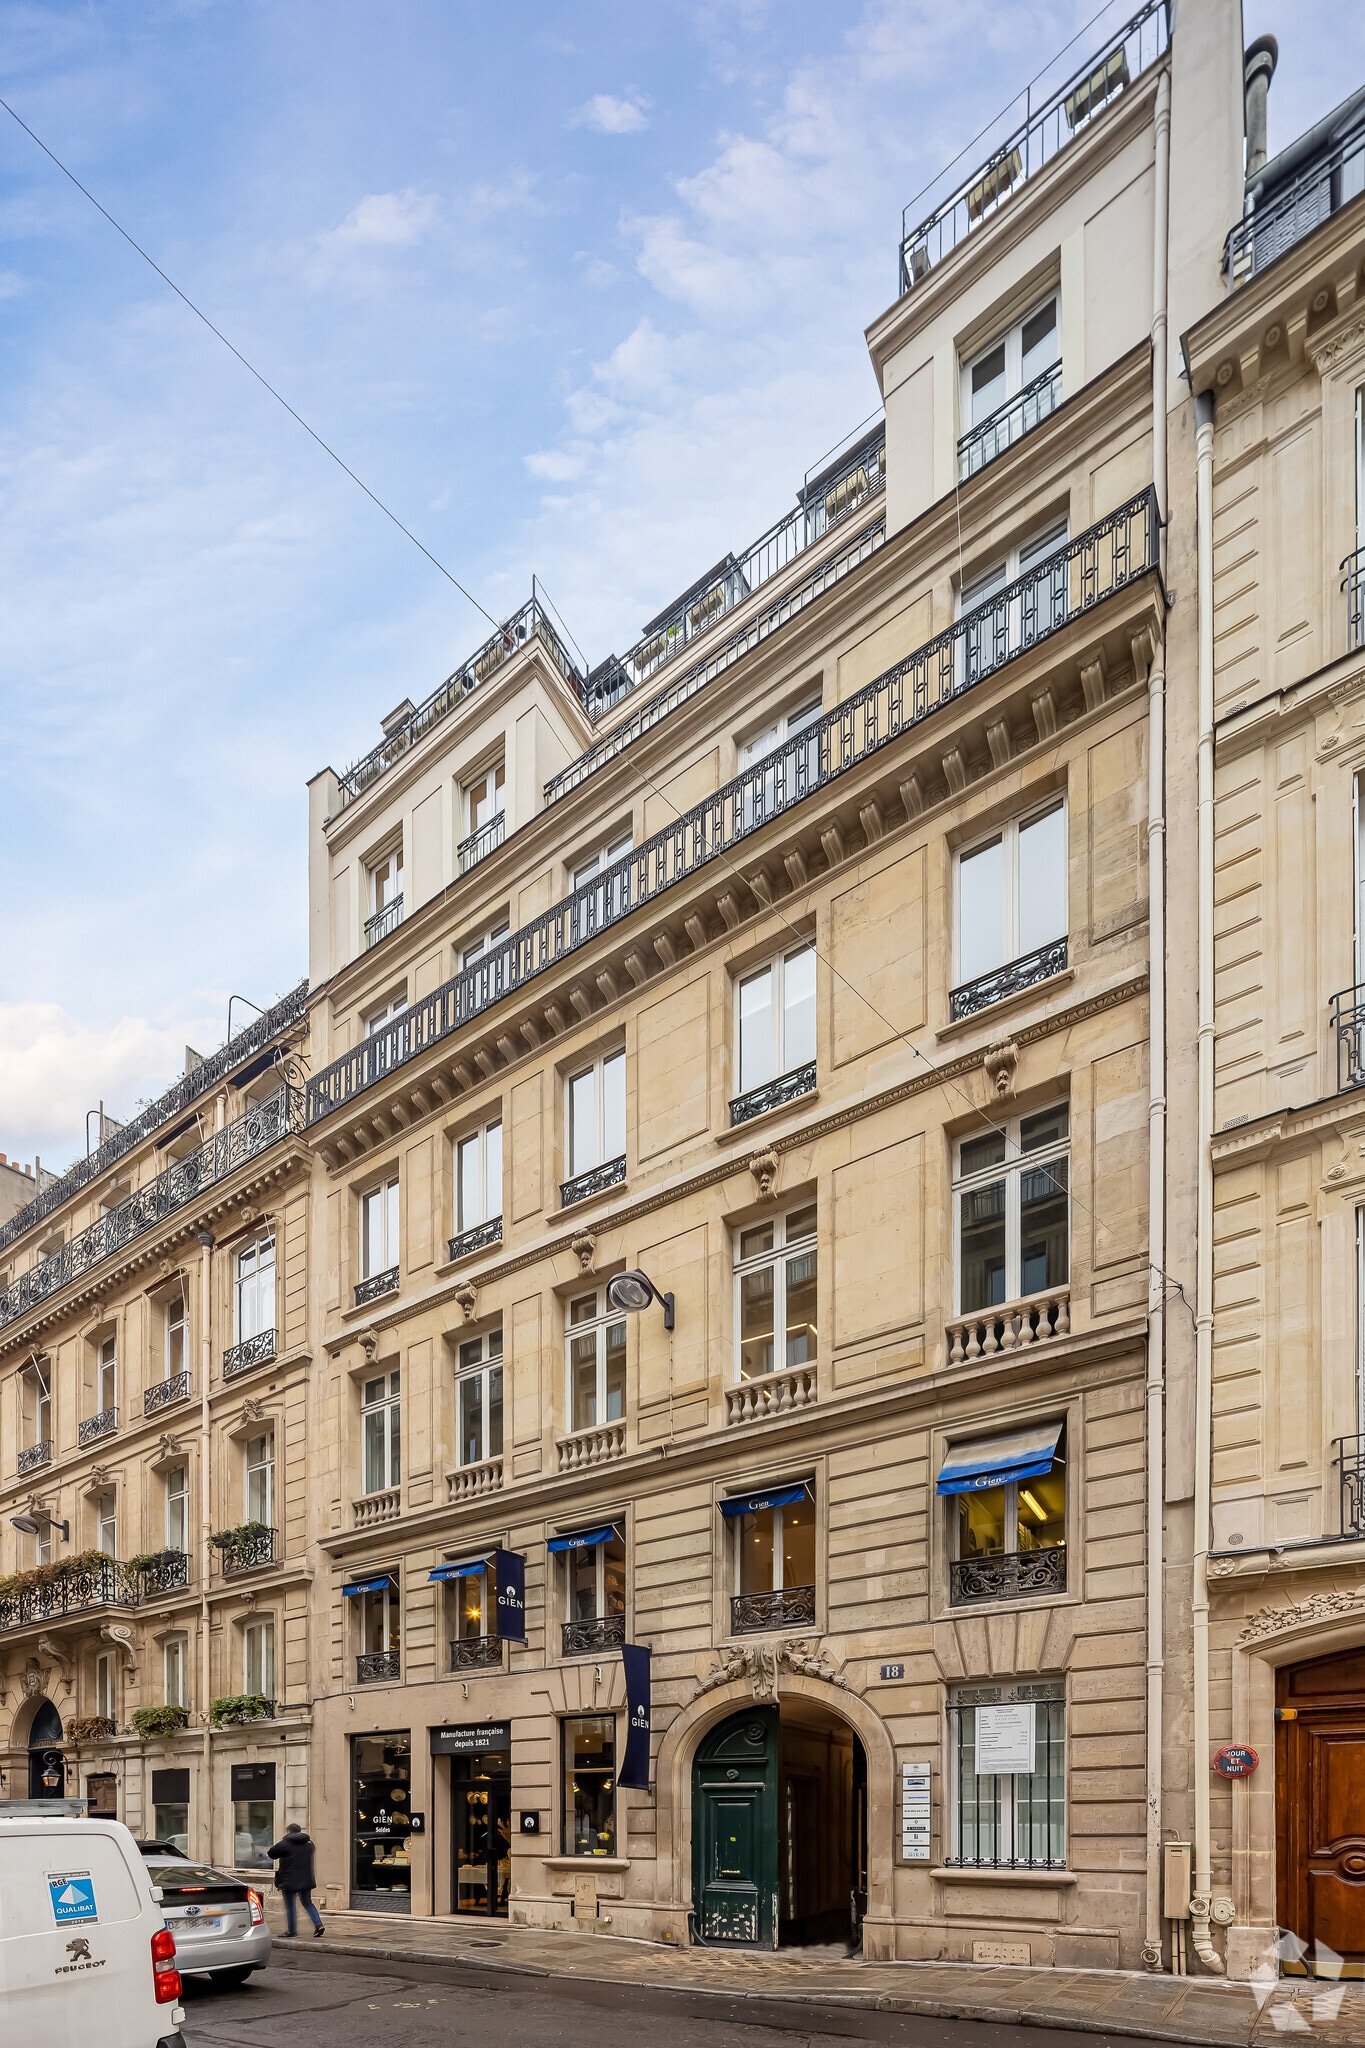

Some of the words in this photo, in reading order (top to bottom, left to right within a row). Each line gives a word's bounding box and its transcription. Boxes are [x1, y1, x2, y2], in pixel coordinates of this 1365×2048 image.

[975, 1476, 1002, 1487] Gien
[749, 1499, 769, 1510] Gien
[498, 1596, 523, 1609] GIEN
[886, 1665, 899, 1678] 18
[631, 1717, 649, 1729] GIEN
[440, 1730, 475, 1739] Manufacture
[476, 1727, 504, 1737] française
[454, 1739, 474, 1749] depuis
[475, 1738, 490, 1746] 1821
[372, 1815, 393, 1824] GIEN
[51, 1878, 68, 1888] RGE
[56, 1904, 94, 1914] QUALIBAT
[54, 1960, 107, 1975] PEUGEOT
